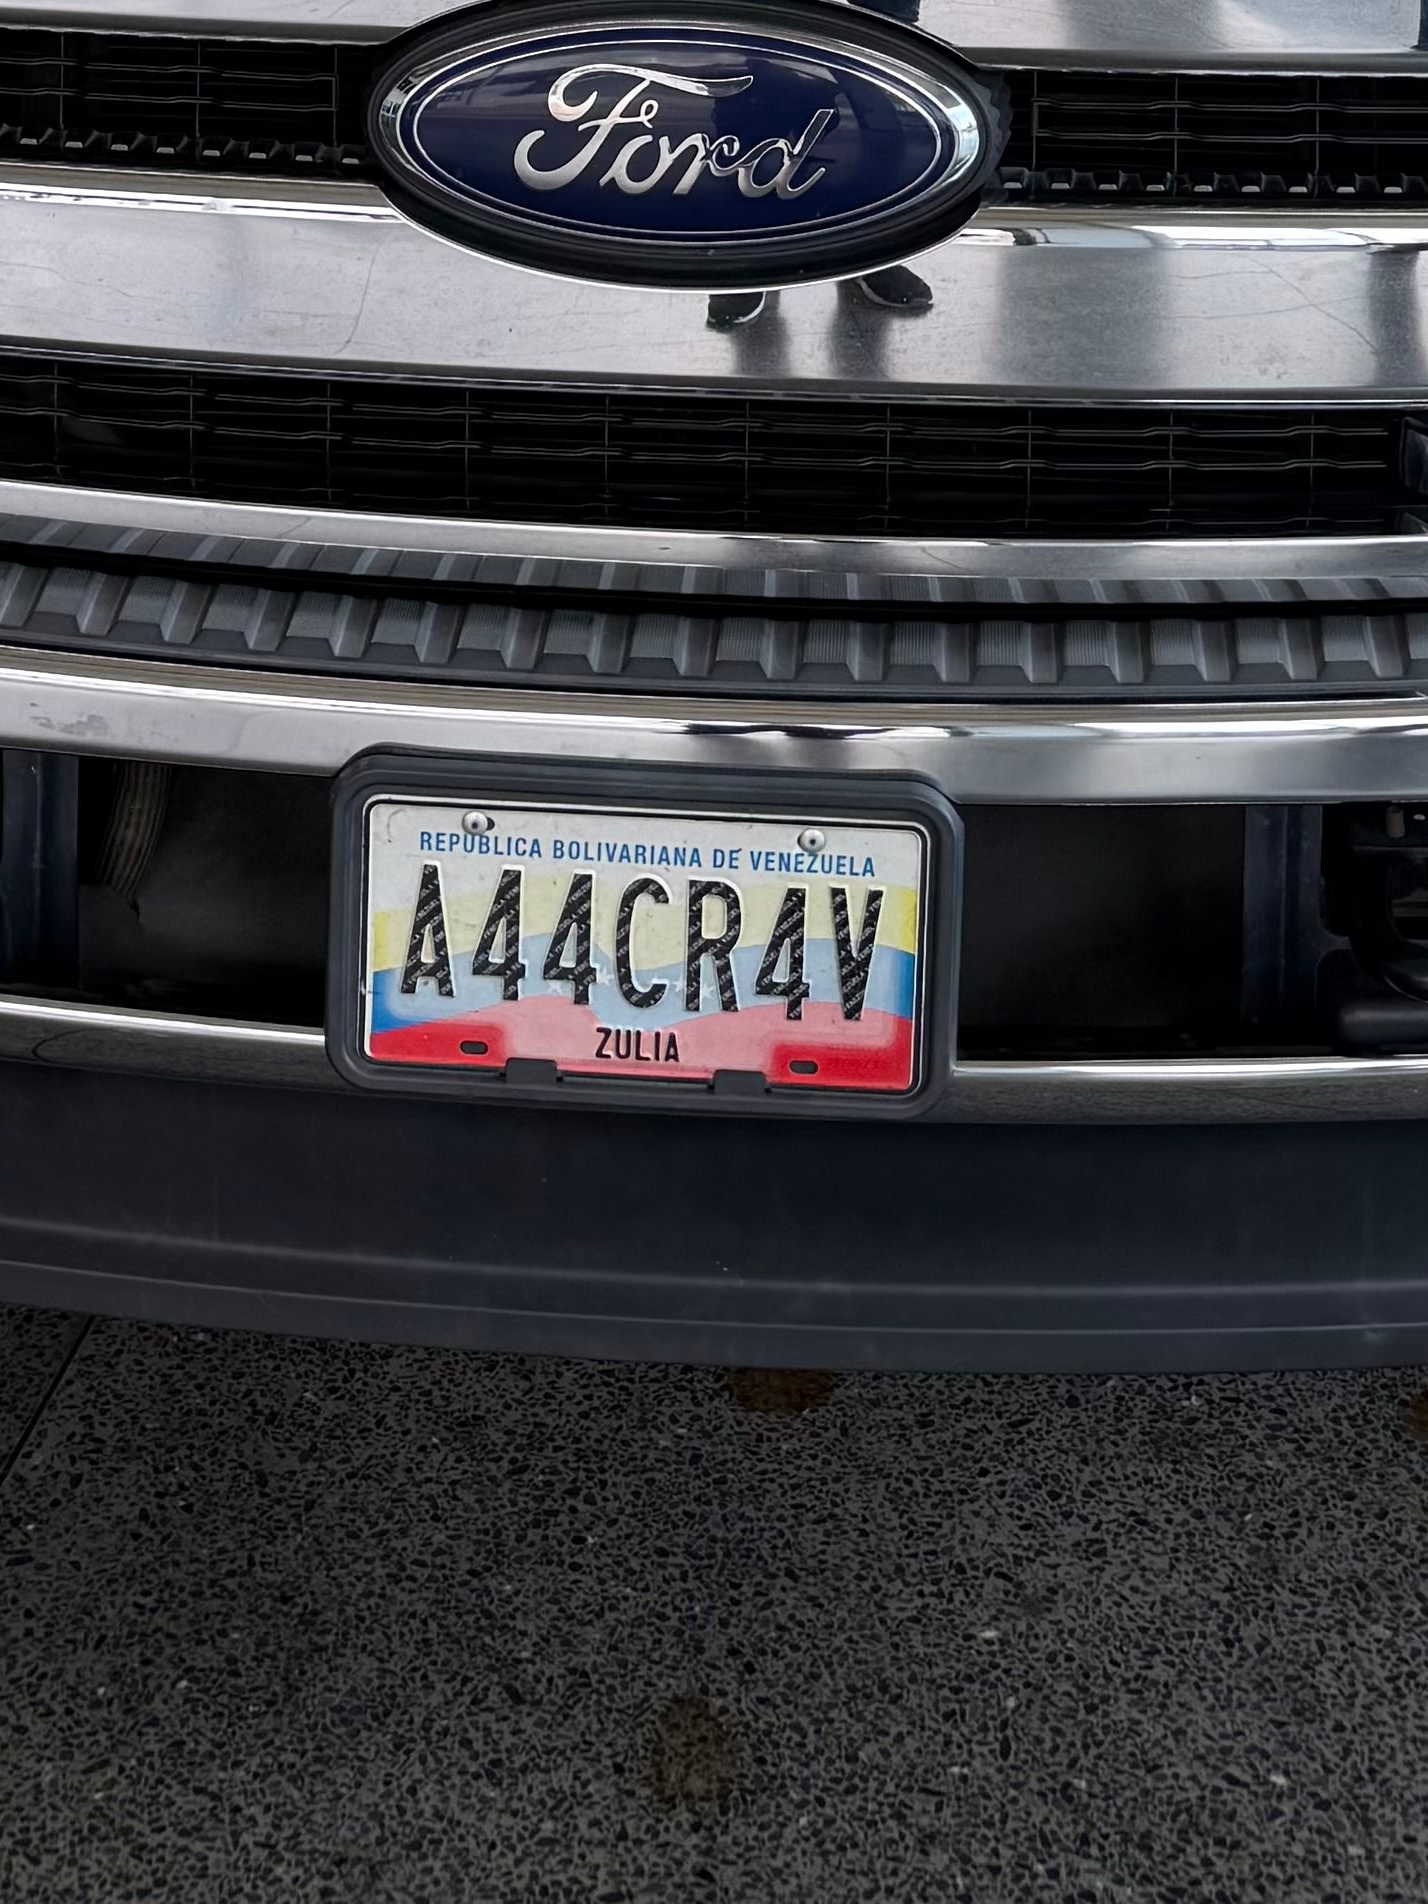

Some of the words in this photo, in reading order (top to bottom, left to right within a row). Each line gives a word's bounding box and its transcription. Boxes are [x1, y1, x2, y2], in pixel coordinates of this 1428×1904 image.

[513, 63, 835, 200] Ford
[419, 831, 543, 858] REPUBLICA
[552, 839, 702, 869] BOLIVARIANA
[712, 848, 741, 870] DE
[750, 850, 876, 878] VENEZUELA
[400, 863, 885, 1021] A44CR4V
[595, 1026, 680, 1063] ZULIA
